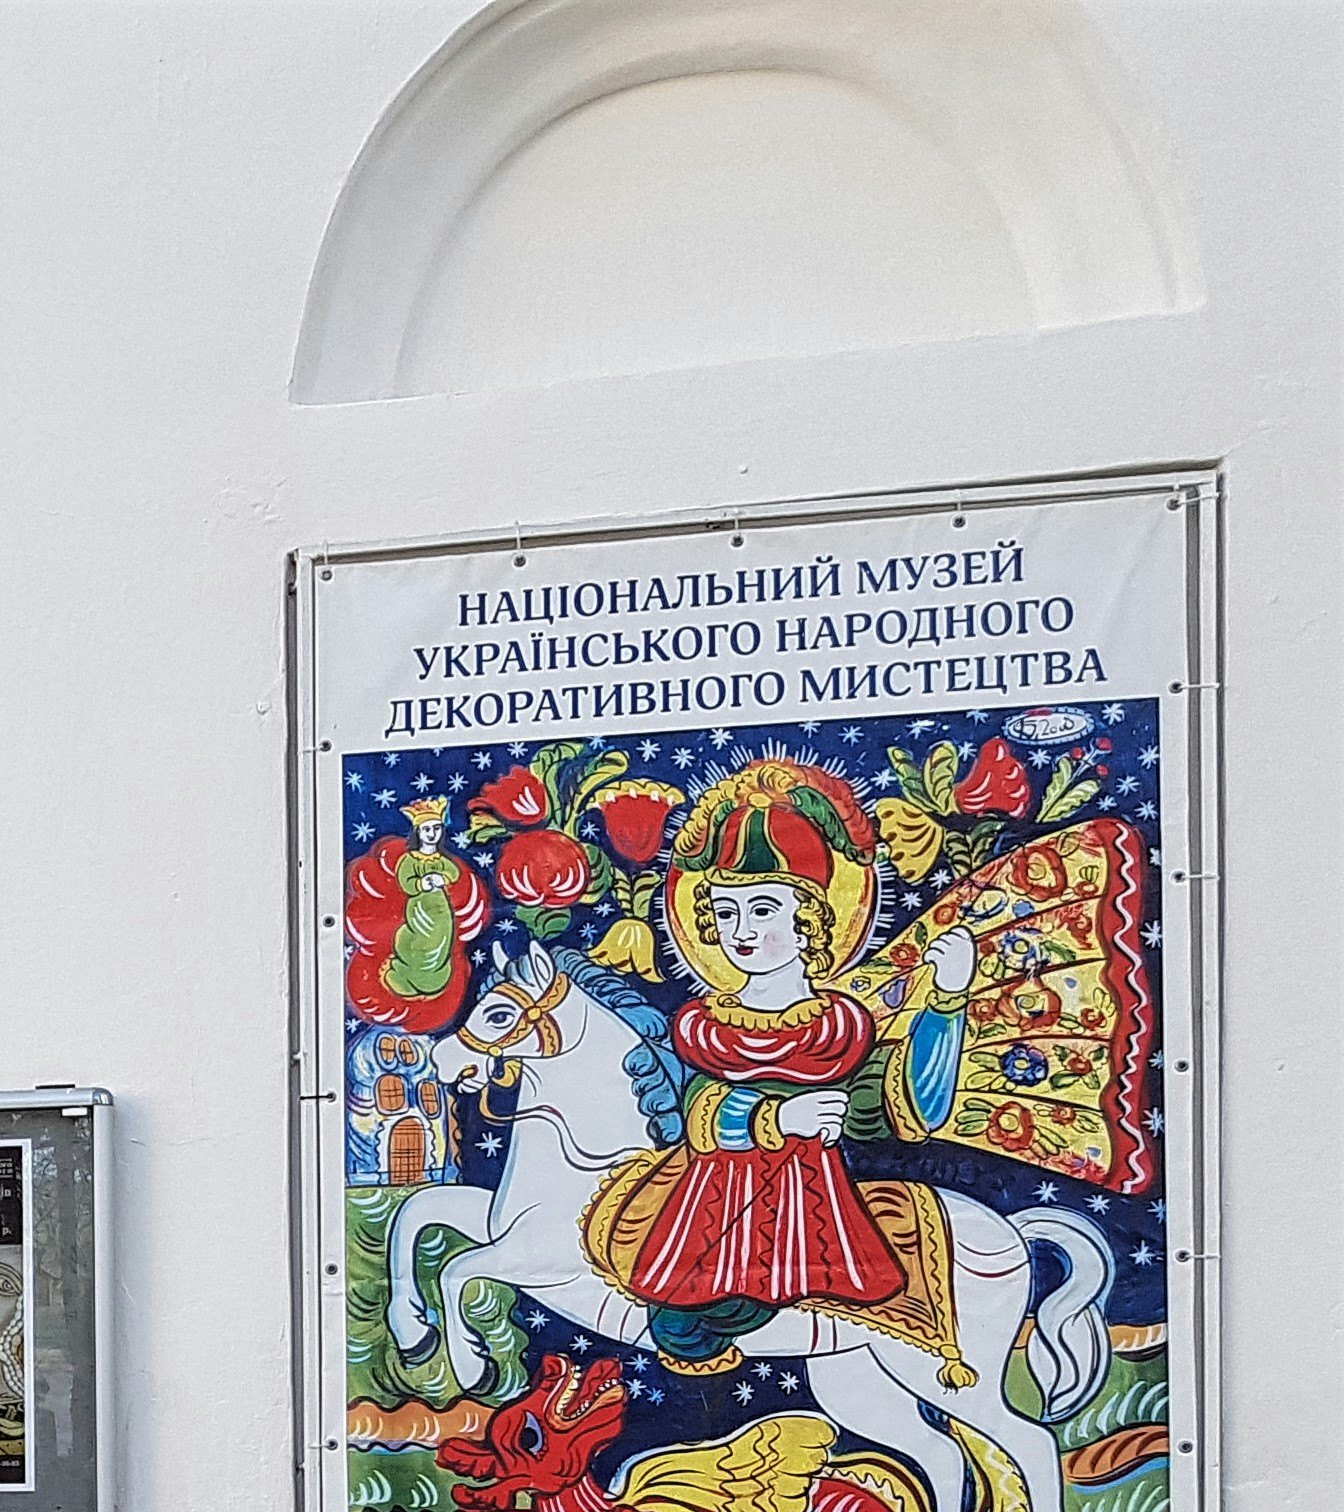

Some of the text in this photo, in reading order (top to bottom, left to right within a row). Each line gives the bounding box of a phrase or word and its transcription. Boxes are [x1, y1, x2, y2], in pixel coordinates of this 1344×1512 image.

[458, 539, 1024, 627] НАЦІОНАЛЬНИЙ МУЗЕЙ
[412, 597, 1074, 681] УКРАЇНСЬКОГО НАРОДНОГО
[384, 648, 1108, 739] ДЕКОРАТИВНОГО МИСТЕЦТВА
